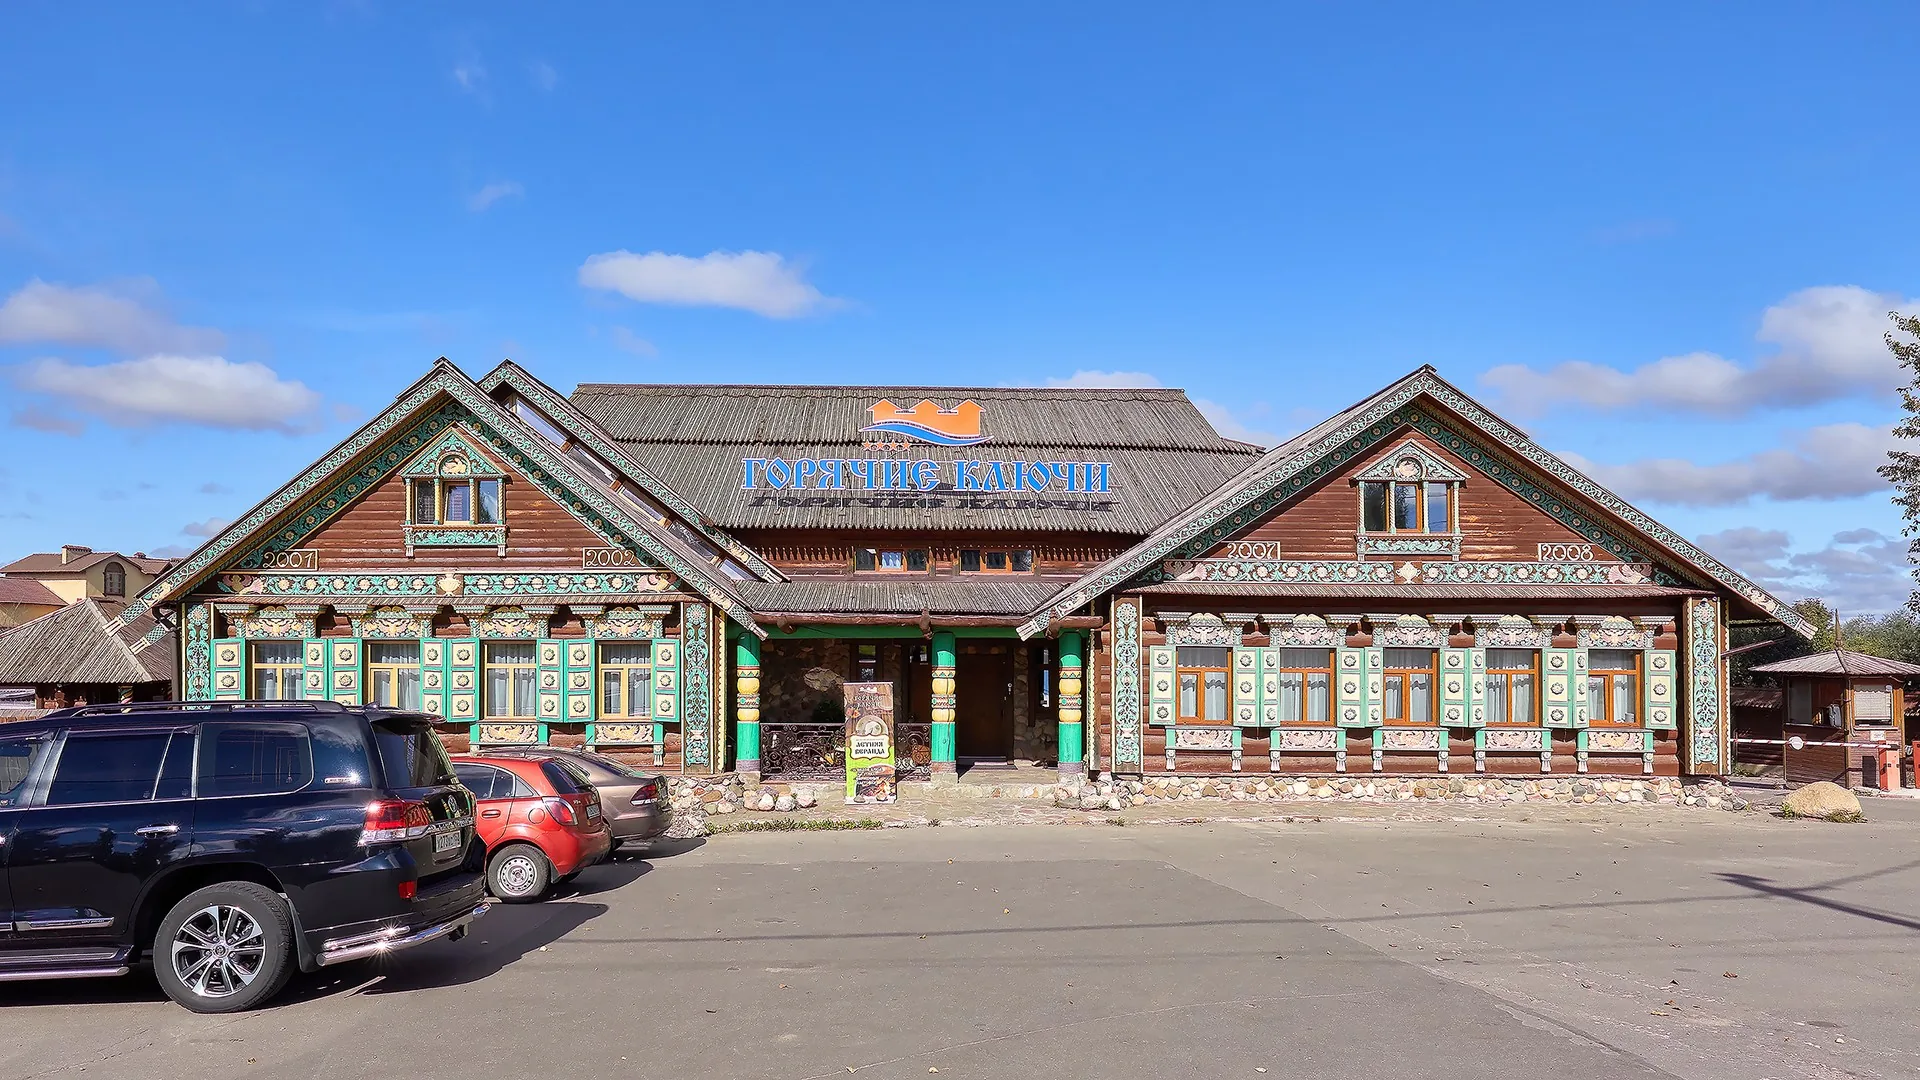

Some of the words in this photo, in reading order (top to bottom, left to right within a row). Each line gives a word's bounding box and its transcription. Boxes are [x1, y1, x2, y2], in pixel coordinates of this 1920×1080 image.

[741, 456, 941, 491] ГОРЯЧИЕ
[953, 459, 1112, 493] КЛЮЧИ
[586, 549, 636, 566] 2002
[1227, 542, 1276, 559] 2007
[1541, 544, 1594, 561] 2008
[262, 551, 314, 568] 2001
